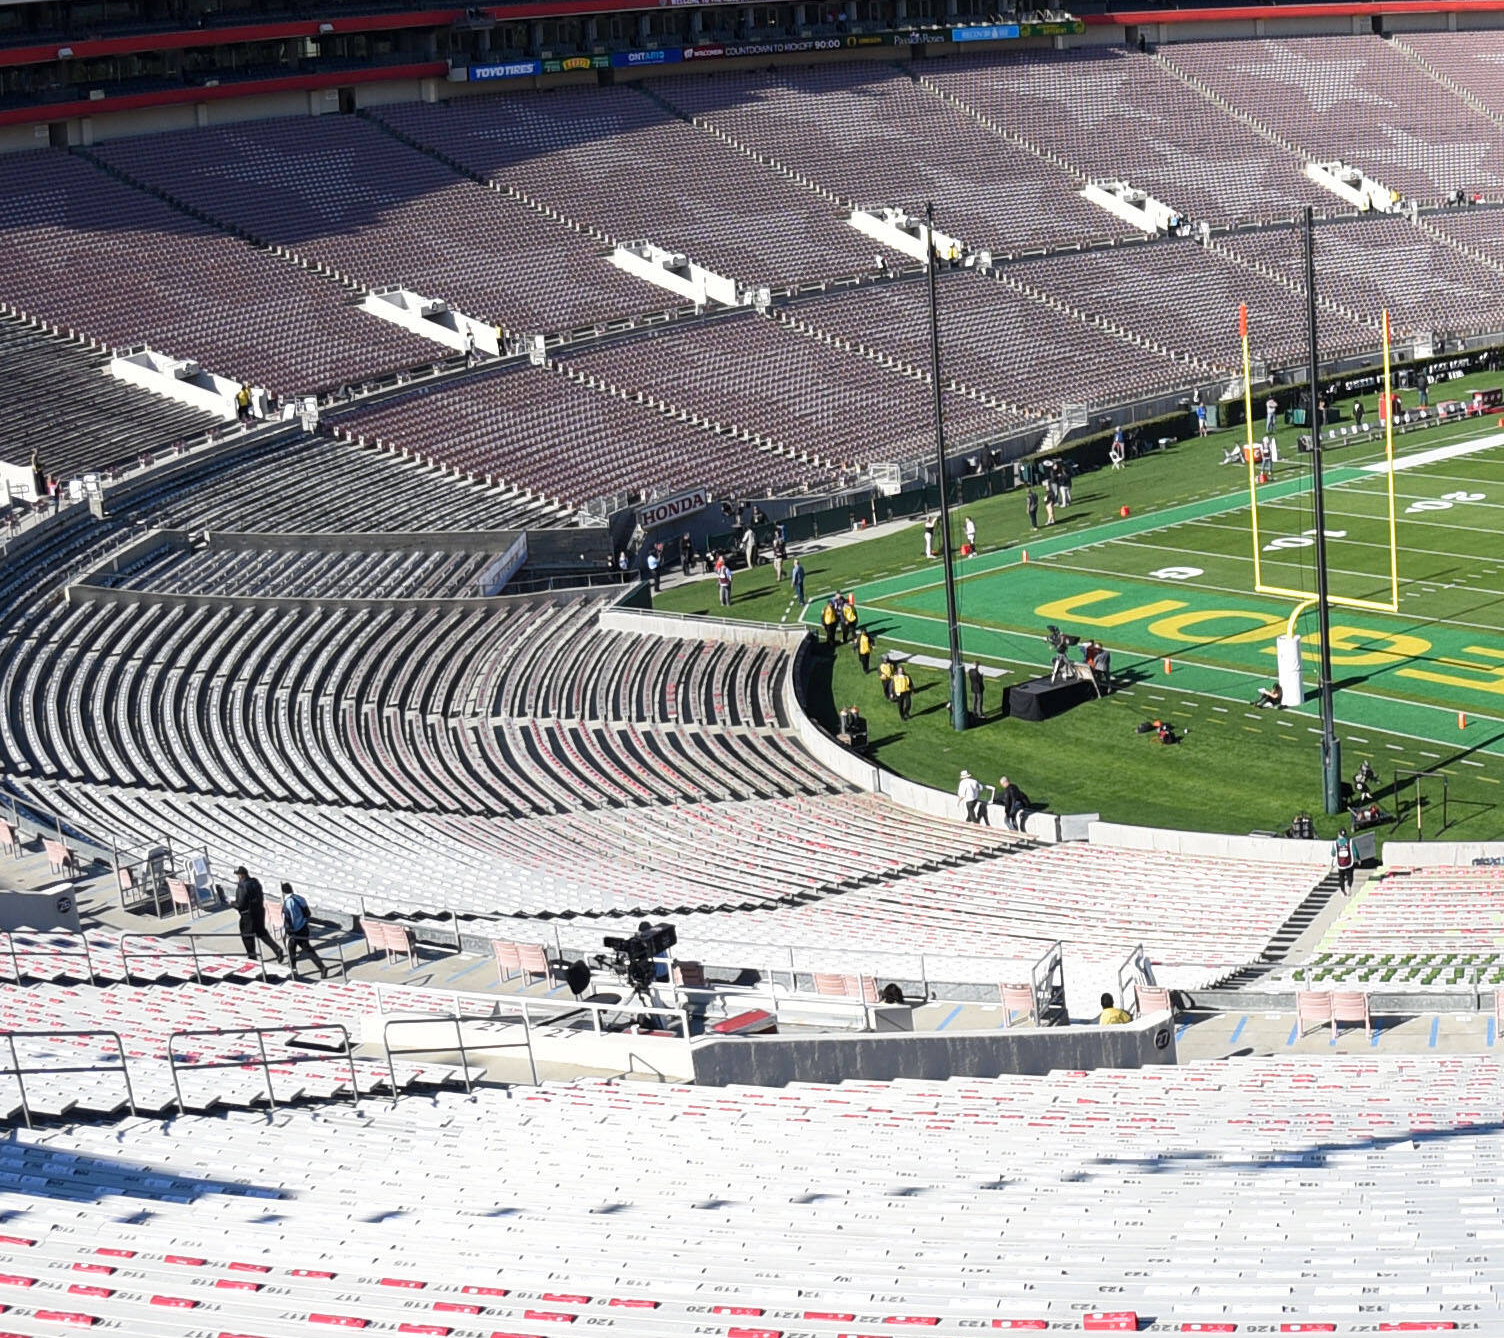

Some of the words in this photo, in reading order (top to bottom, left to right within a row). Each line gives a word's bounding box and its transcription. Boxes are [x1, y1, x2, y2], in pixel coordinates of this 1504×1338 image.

[814, 39, 841, 50] 90:00
[475, 65, 504, 78] TOYO
[505, 63, 534, 76] TIRES
[1411, 491, 1487, 513] 20
[477, 1022, 514, 1032] 27
[544, 1028, 582, 1039] 27
